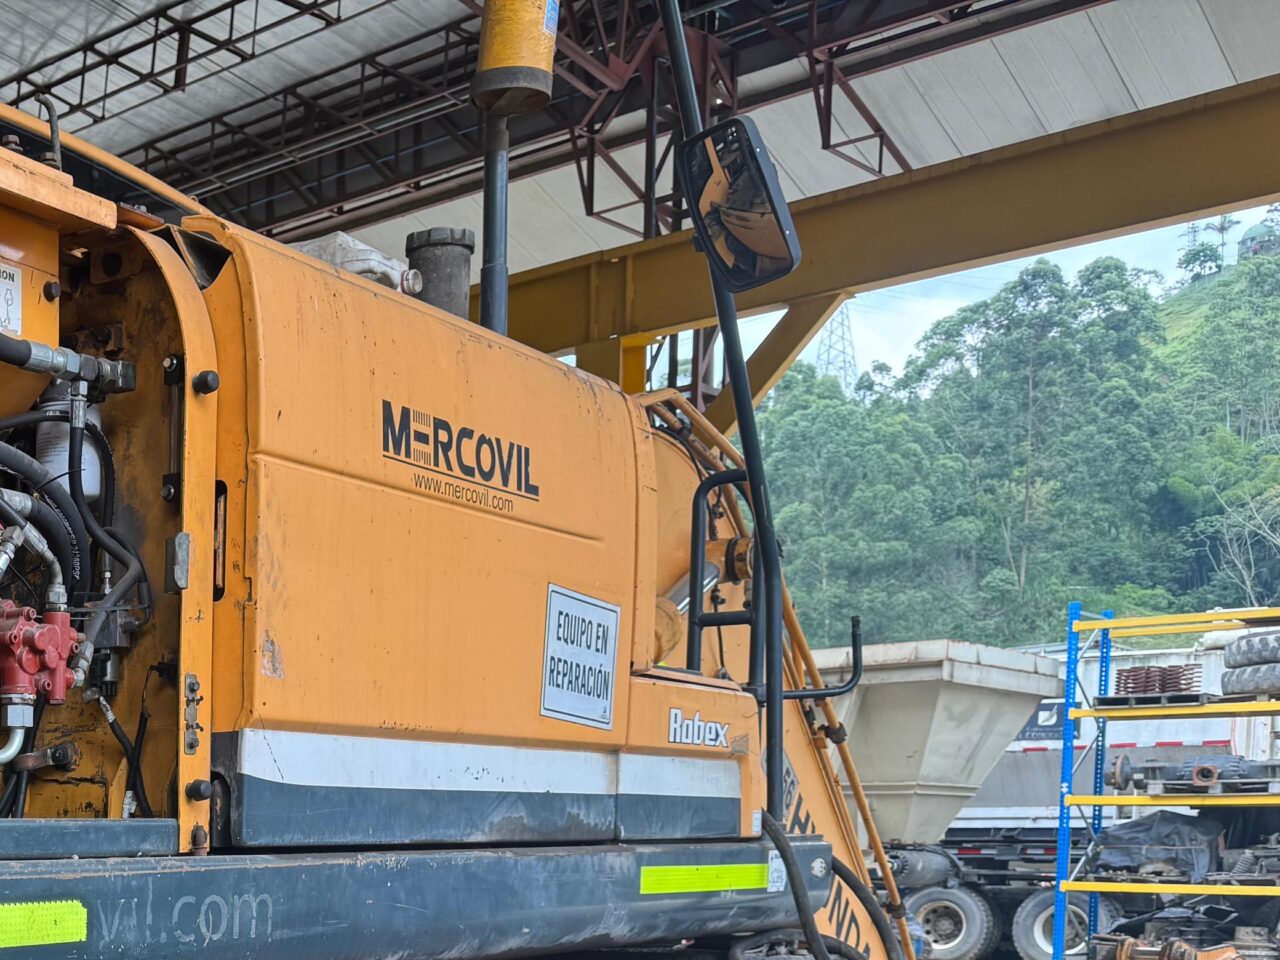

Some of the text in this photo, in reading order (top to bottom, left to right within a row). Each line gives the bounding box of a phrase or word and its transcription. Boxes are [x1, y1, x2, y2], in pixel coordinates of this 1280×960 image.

[382, 399, 539, 497] MERCOVIL
[413, 473, 514, 513] www.mercovil.com
[556, 610, 609, 655] EQUIPO EN
[548, 656, 610, 701] REPARACIÓN
[668, 708, 729, 748] Robex
